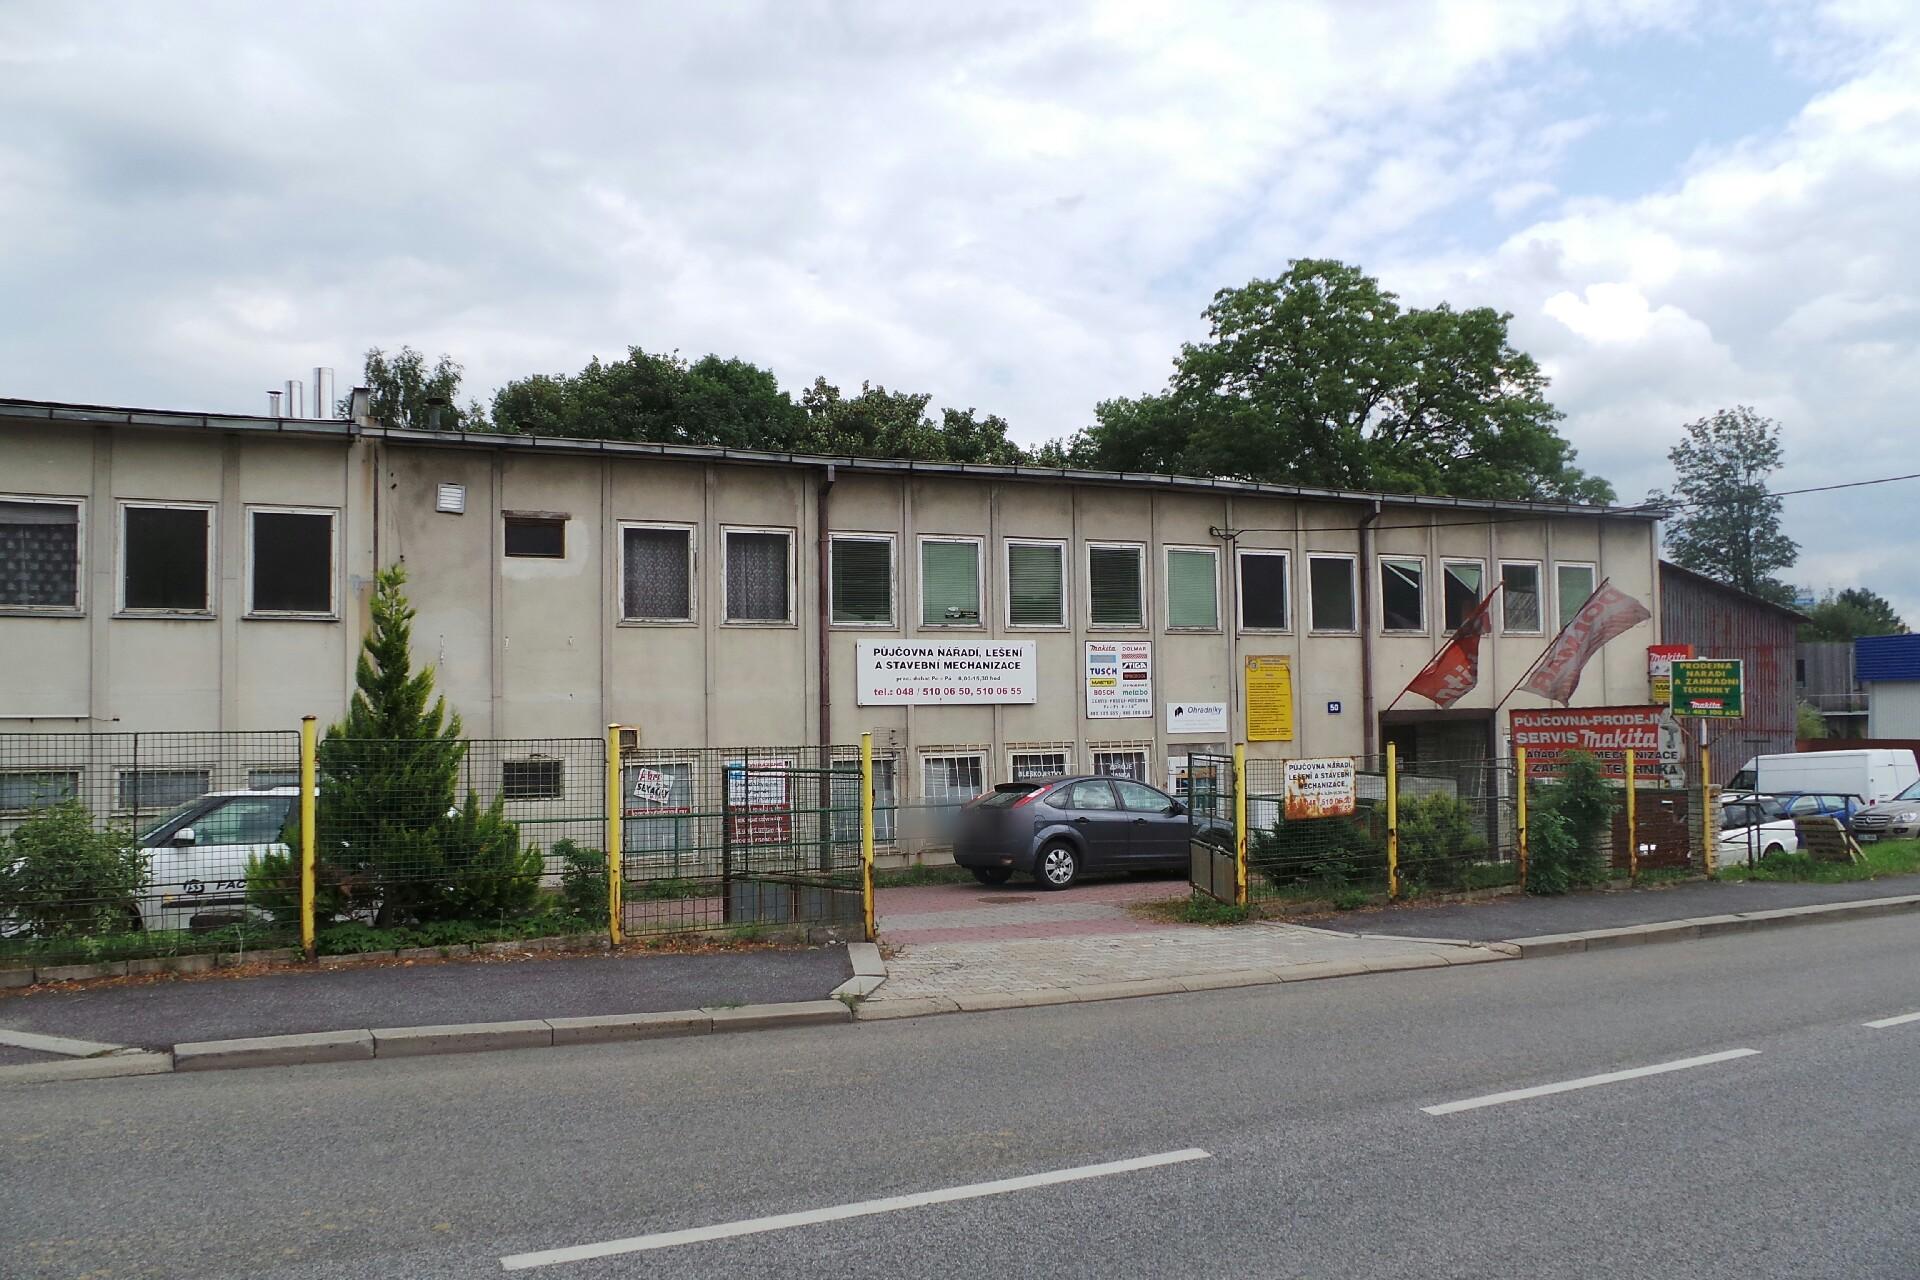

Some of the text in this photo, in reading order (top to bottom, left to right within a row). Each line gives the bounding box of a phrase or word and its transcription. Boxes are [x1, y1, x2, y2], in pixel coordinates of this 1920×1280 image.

[873, 646, 1024, 658] PŮJČOVNA NÁŘADÍ, LEŠENÍ
[875, 659, 1021, 670] A STAVEBNÍ MECHANIZACE
[896, 687, 914, 696] 048
[923, 687, 940, 696] 510
[944, 687, 956, 696] 06
[958, 687, 974, 697] 50,
[976, 687, 994, 696] 510
[996, 687, 1008, 696] 06
[1011, 687, 1022, 696] 55
[1682, 686, 1730, 694] TECHNIKY
[1330, 703, 1339, 711] 50
[1516, 731, 1579, 744] SERVIS
[1594, 751, 1678, 760] MECHNIZACE
[1605, 764, 1678, 775] TEHNIKA
